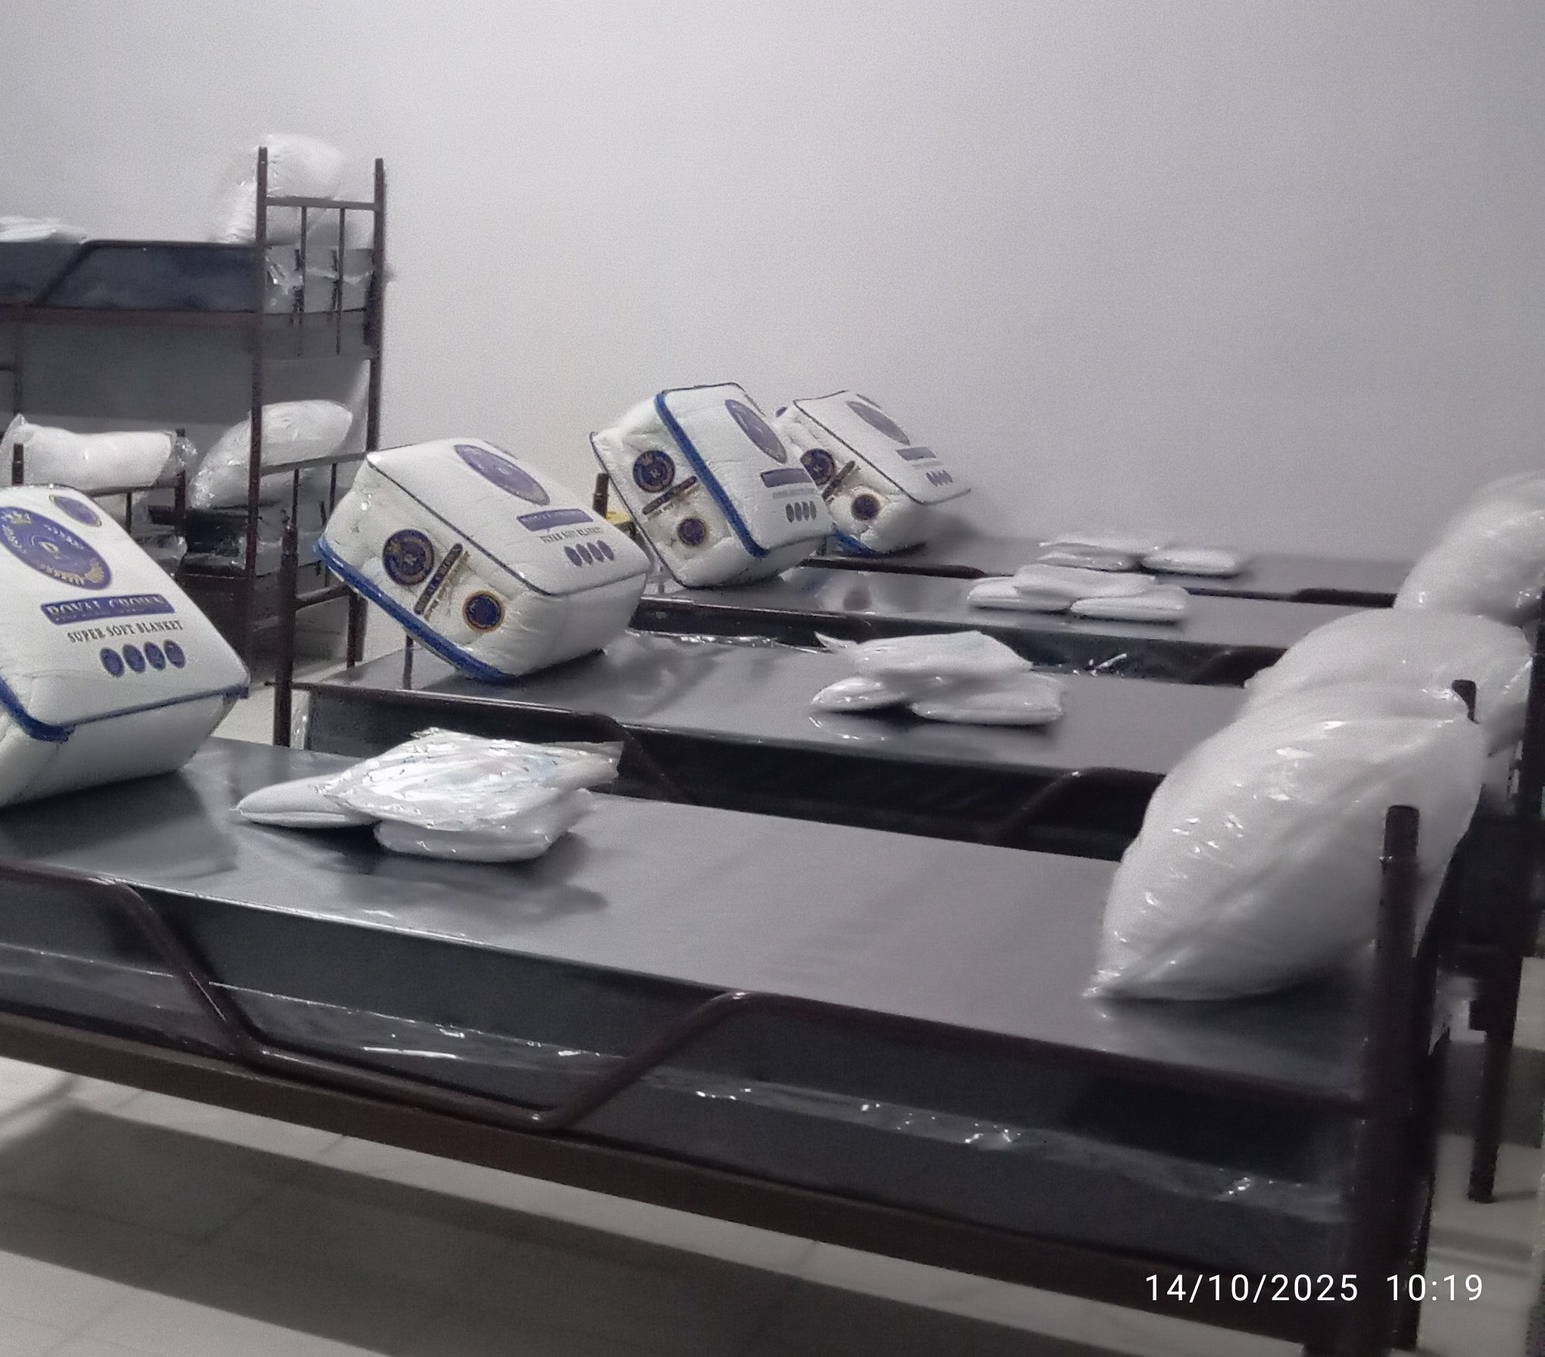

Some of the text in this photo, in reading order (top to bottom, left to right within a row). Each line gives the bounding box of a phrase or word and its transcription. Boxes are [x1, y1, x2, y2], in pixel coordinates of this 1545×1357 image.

[46, 599, 100, 615] ROYAL
[66, 619, 184, 644] SUPER SOFT BLANKET
